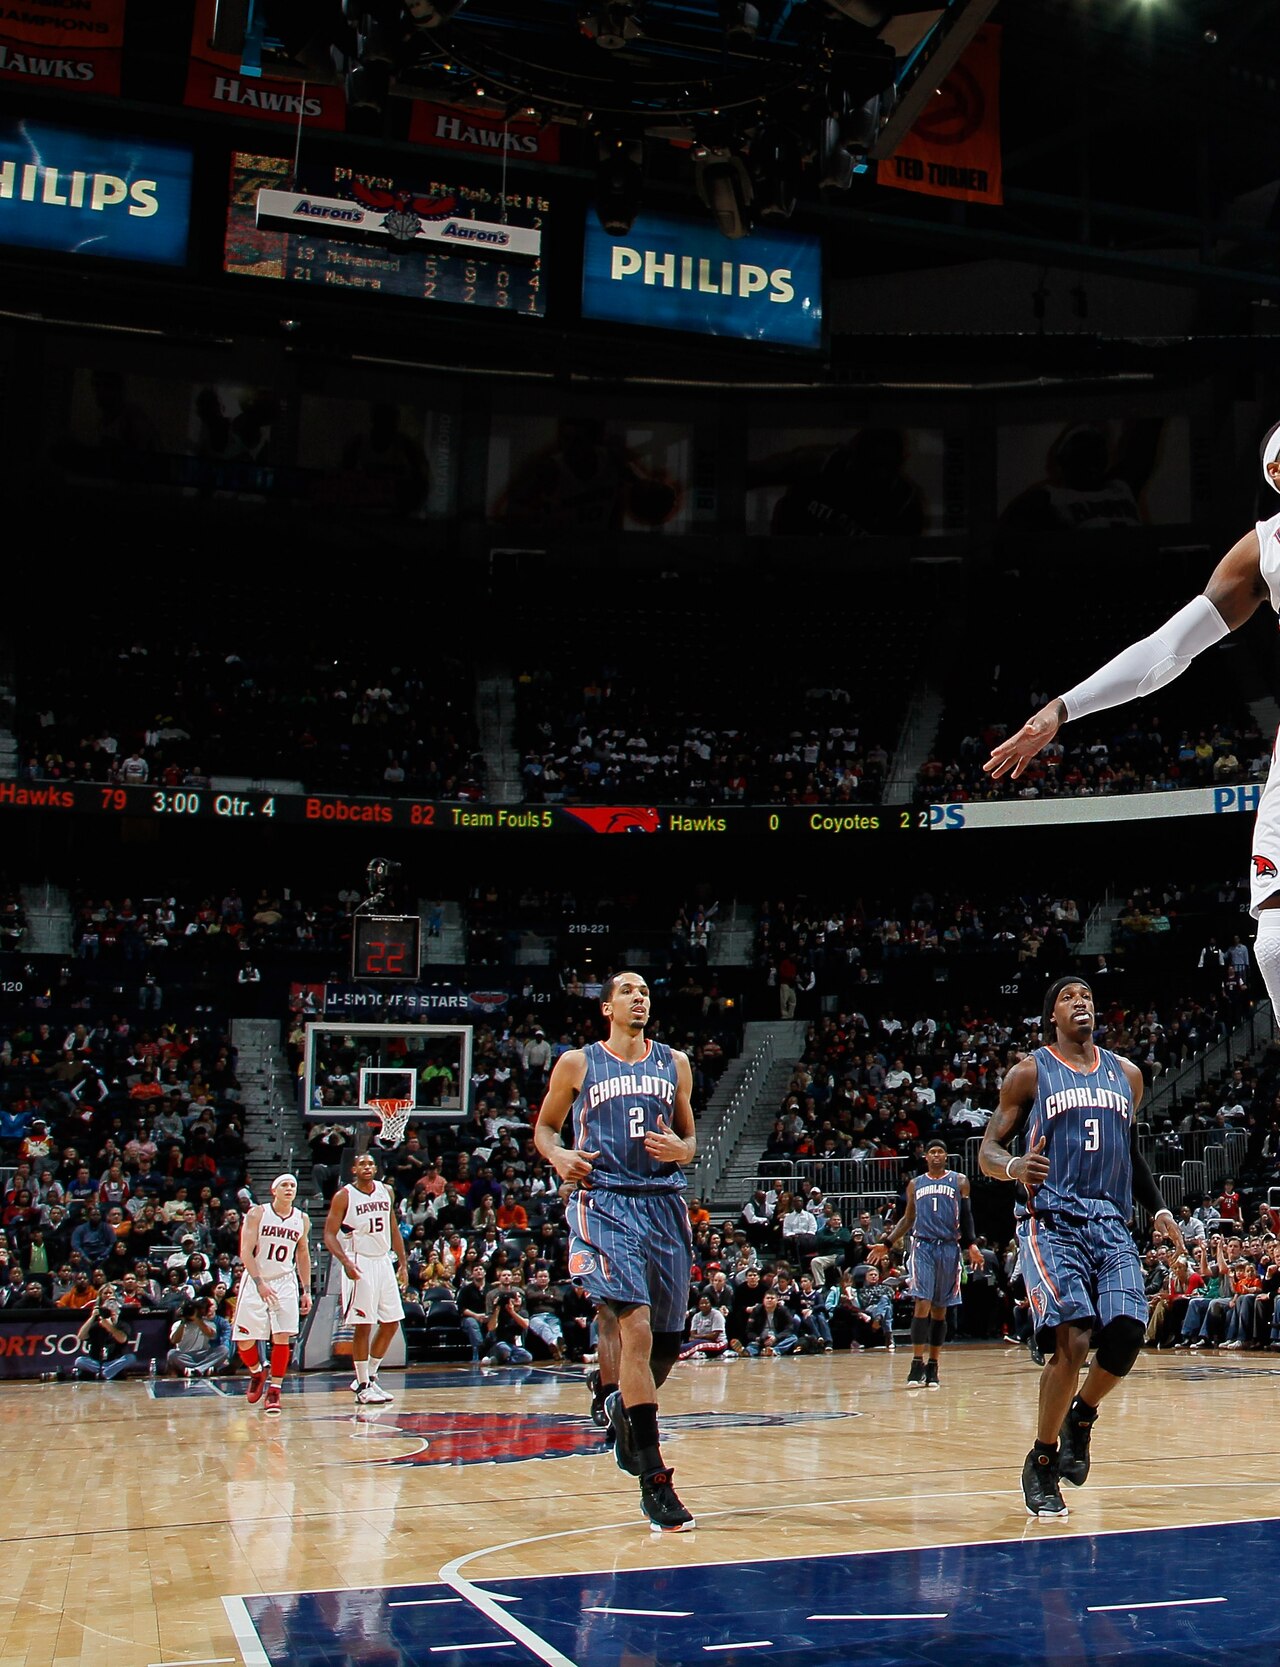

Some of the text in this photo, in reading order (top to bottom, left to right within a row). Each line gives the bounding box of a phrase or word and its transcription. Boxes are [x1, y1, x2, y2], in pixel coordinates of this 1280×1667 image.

[0, 8, 109, 34] AMPIONS
[213, 76, 323, 117] HAWKS
[435, 115, 539, 152] HAWKS
[894, 156, 988, 193] TED TURNER
[294, 200, 365, 224] Aaron's
[442, 222, 510, 246] Aaron's
[293, 266, 312, 281] 21
[611, 246, 795, 303] PHILIPS
[0, 783, 928, 834] Hawks 79 3:00 Qtr. 4 Bobcats 82 Team Fouls 5 Hawks 0 Coyotes 2 2
[1213, 786, 1261, 813] PH
[568, 924, 610, 934] 219-221
[366, 941, 406, 972] 22
[2, 981, 23, 992] 120
[532, 993, 551, 1003] 121
[1000, 984, 1019, 994] 122
[420, 994, 469, 1011] STARS
[588, 1074, 676, 1110] CHARLOTTE
[1045, 1087, 1130, 1121] CHARLOTTE
[628, 1106, 646, 1139] 2
[1084, 1118, 1100, 1152] 3
[915, 1183, 957, 1201] CHARLOTTE
[354, 1199, 391, 1216] HAWKS
[931, 1197, 938, 1212] 1
[260, 1224, 300, 1243] HAWKS
[368, 1217, 385, 1234] 15
[266, 1243, 289, 1263] 10
